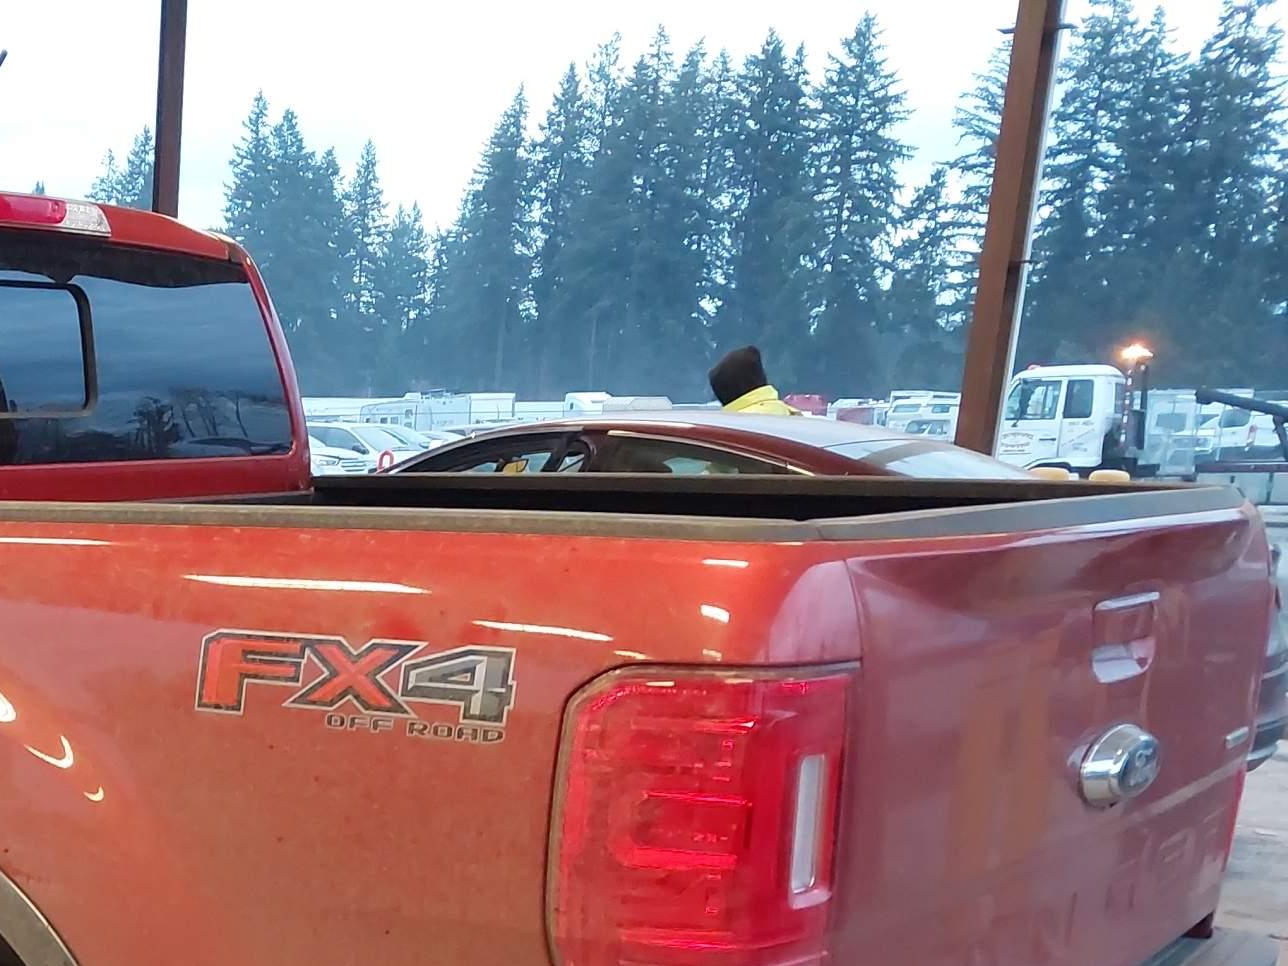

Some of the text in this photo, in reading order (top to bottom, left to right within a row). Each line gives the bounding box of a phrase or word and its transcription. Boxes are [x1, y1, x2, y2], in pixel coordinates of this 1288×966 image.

[195, 628, 516, 727] FX4
[326, 713, 504, 744] OFF ROAD
